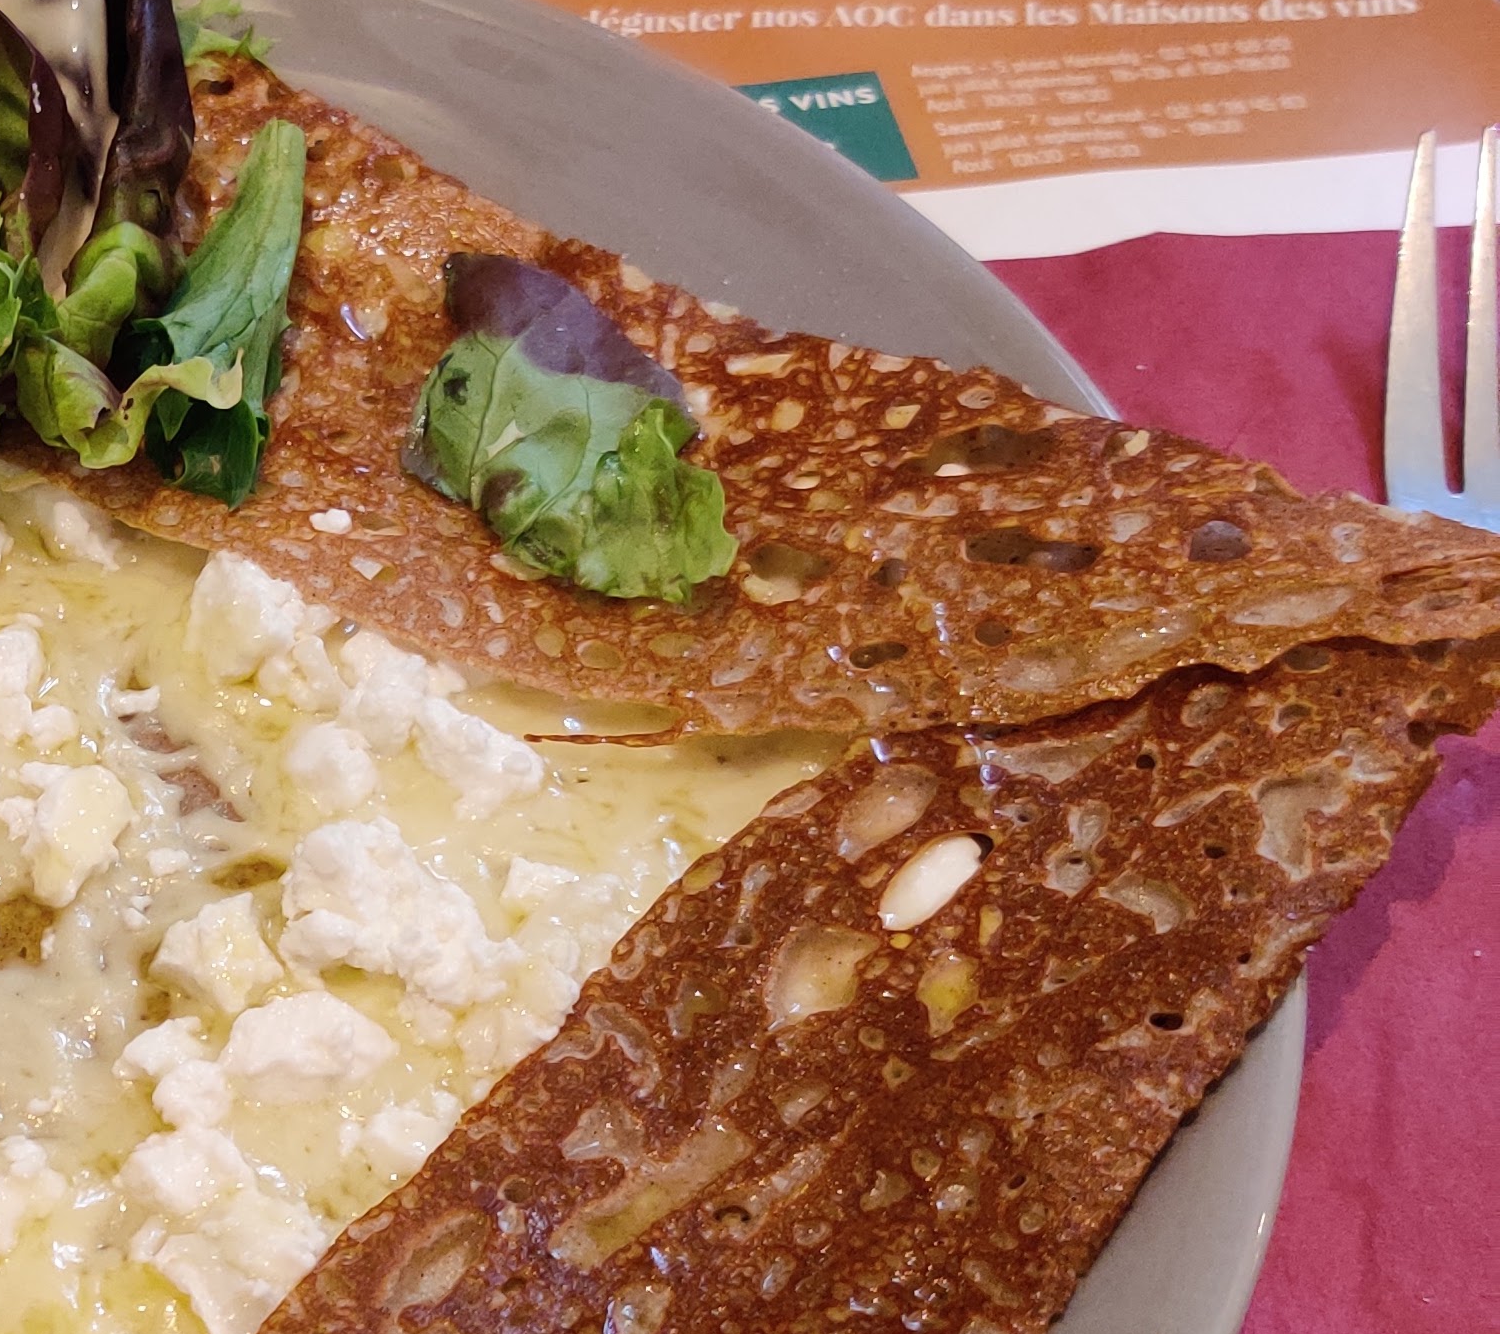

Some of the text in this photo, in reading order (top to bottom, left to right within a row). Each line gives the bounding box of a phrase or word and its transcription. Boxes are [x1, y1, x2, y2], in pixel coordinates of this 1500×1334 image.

[752, 8, 819, 29] nos
[823, 3, 915, 29] AOC
[925, 2, 1018, 28] dans
[1024, 1, 1078, 26] les
[1088, 0, 1250, 25] Maisons
[789, 87, 878, 112] VINS
